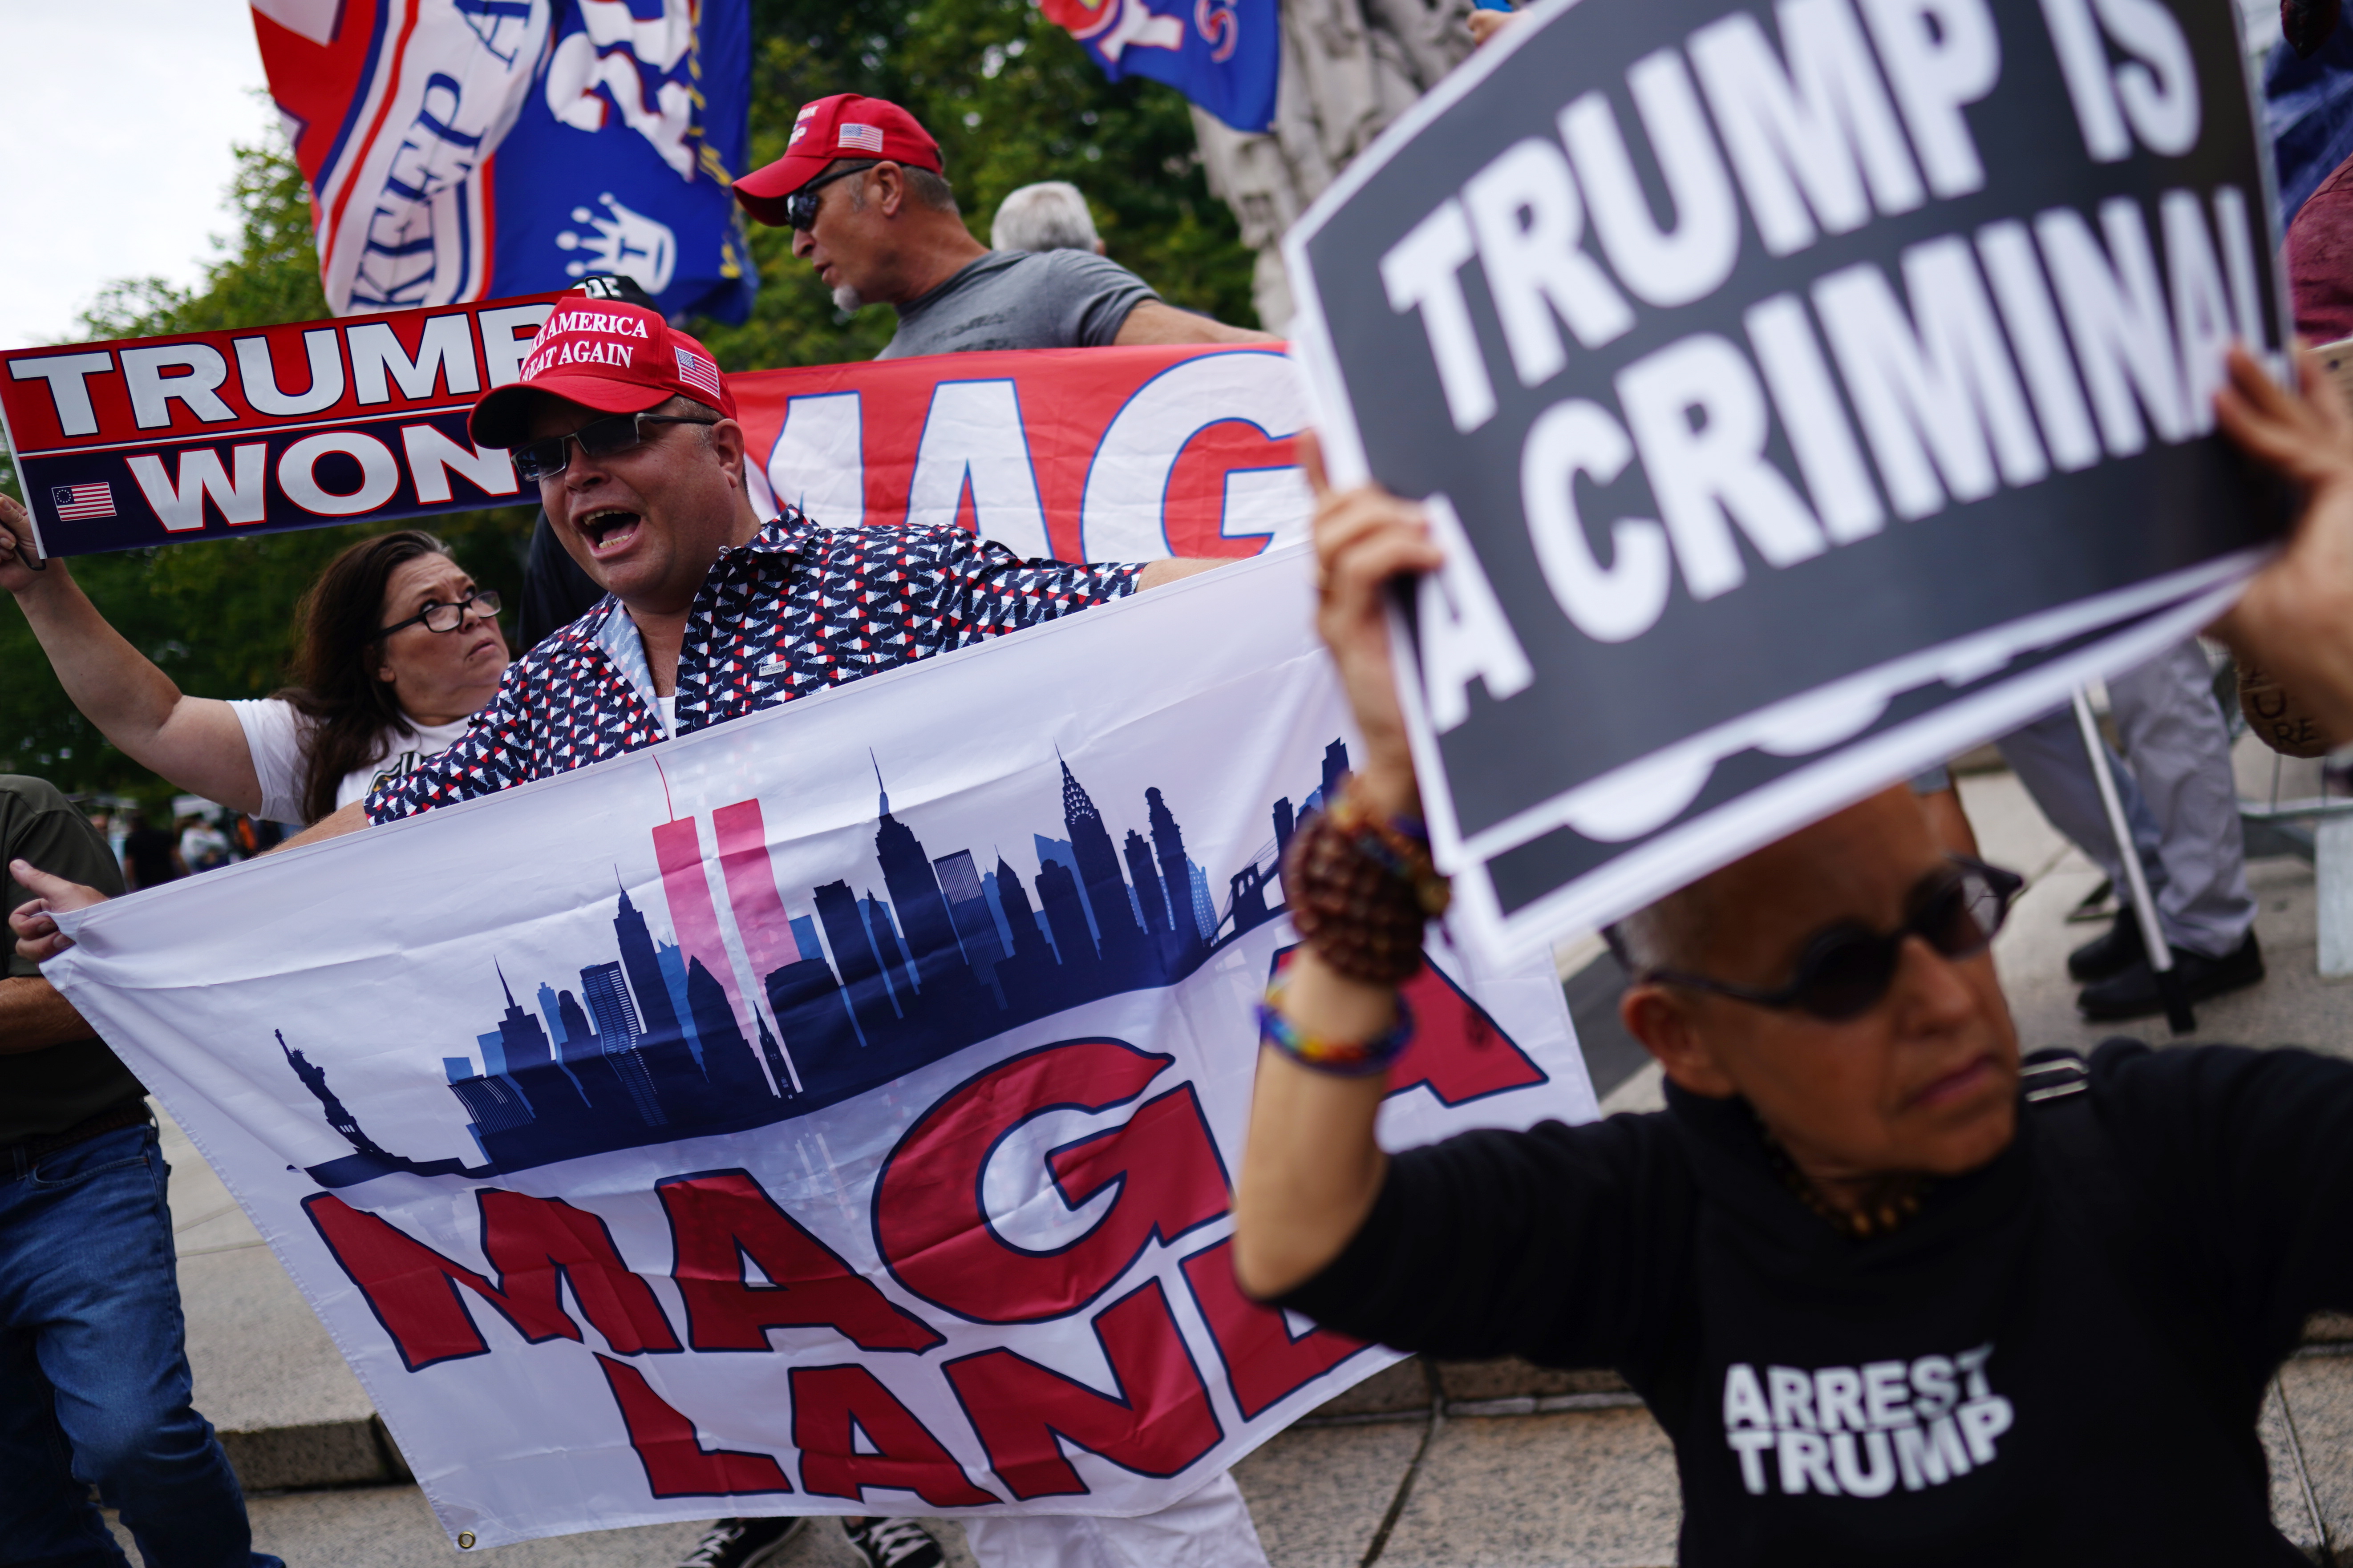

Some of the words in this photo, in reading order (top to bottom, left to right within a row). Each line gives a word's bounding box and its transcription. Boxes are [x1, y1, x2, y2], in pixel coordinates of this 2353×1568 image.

[1376, 0, 2001, 435] TRUMP
[2040, 0, 2203, 165] IS
[546, 311, 648, 339] AMERICA
[557, 340, 634, 369] AGAIN
[126, 423, 521, 533] WON
[1417, 493, 1534, 736] A
[1722, 1339, 1995, 1431] ARREST
[1725, 1394, 2015, 1498] TRUMP
